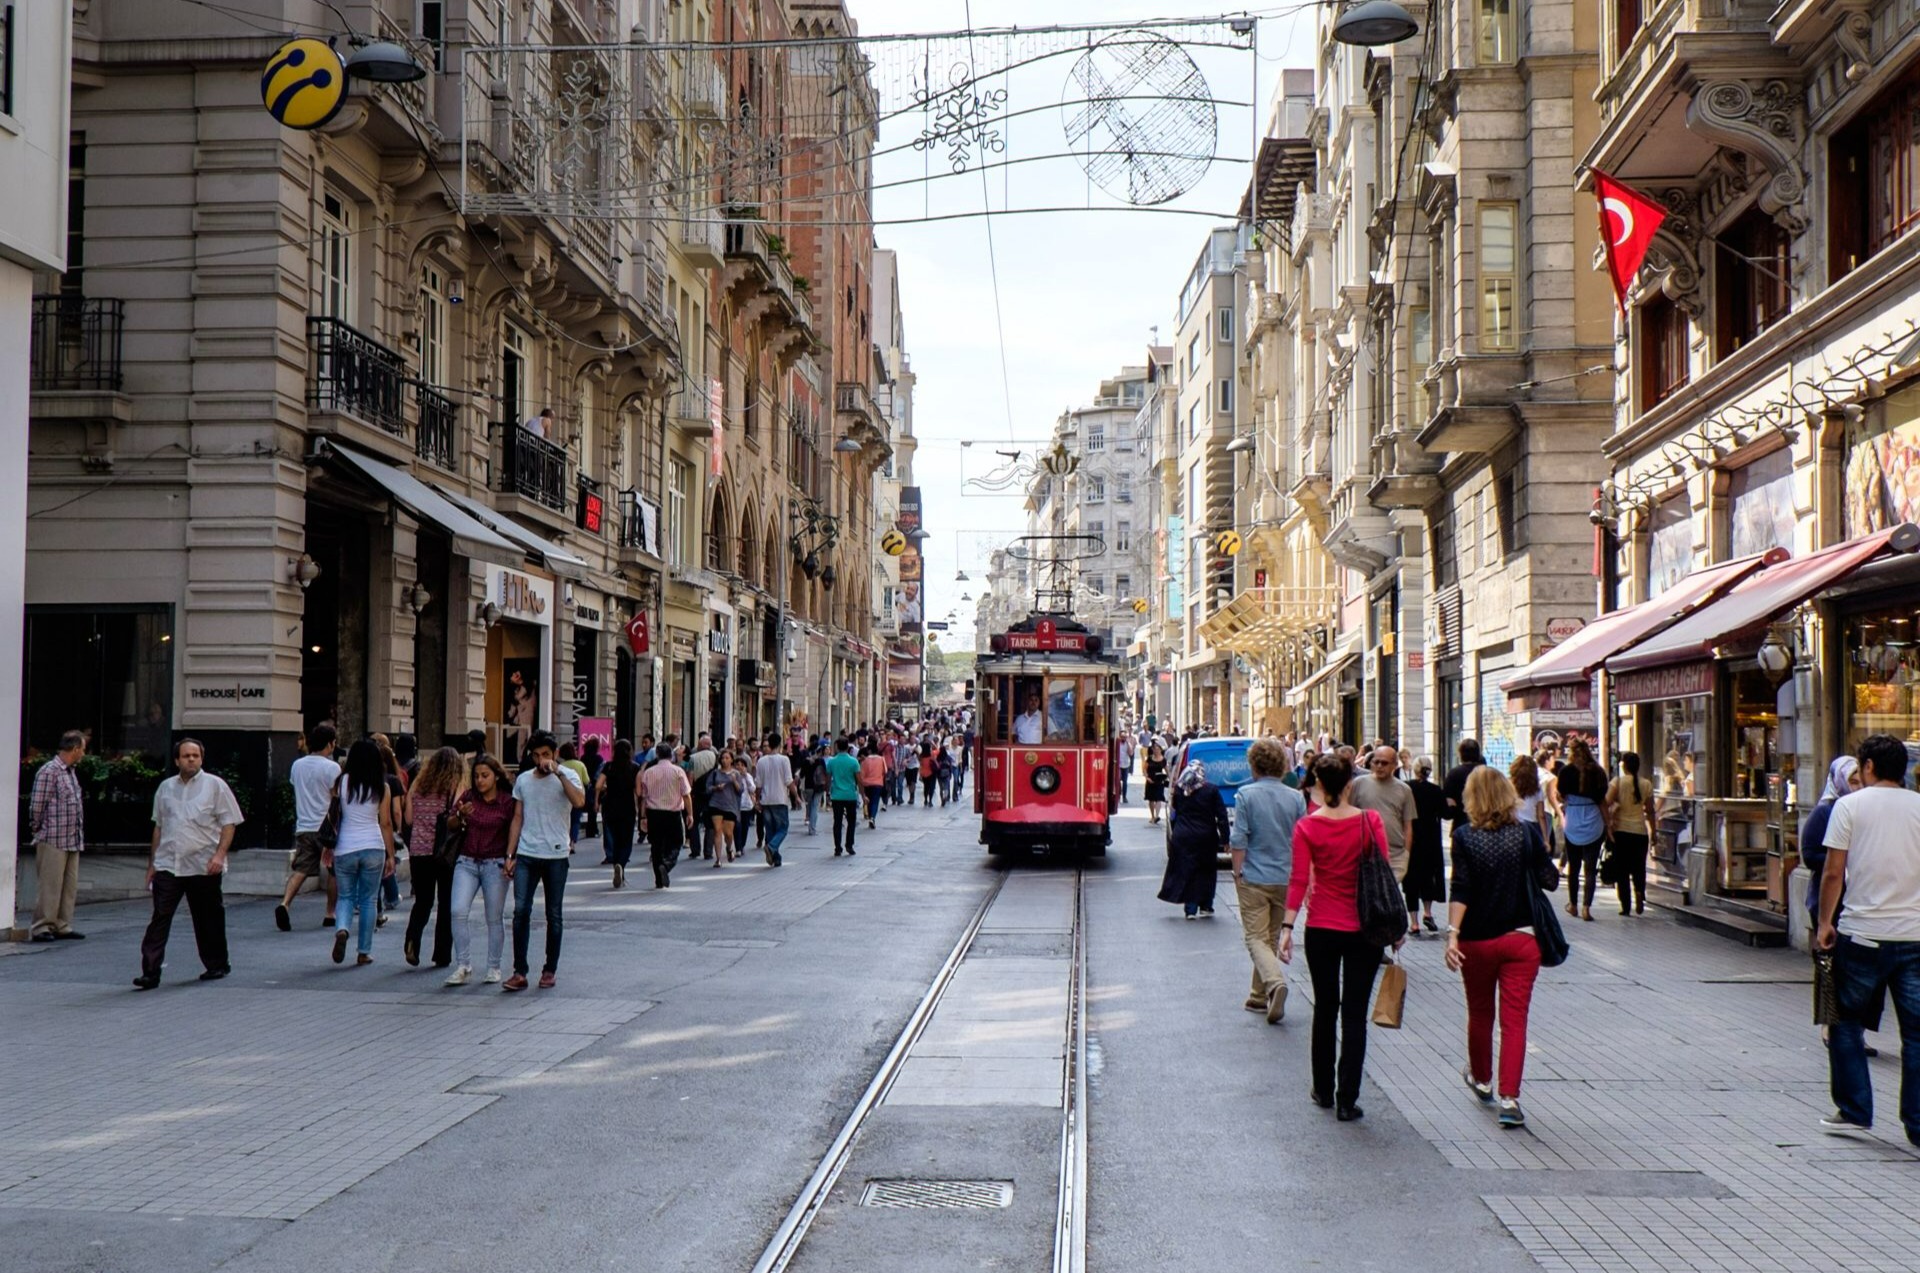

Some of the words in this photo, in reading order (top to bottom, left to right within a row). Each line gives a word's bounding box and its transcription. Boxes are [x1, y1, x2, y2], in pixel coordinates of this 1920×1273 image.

[1043, 621, 1049, 633] 3
[1055, 636, 1081, 649] TÜNEL
[1620, 672, 1660, 699] TURKISH
[1661, 664, 1708, 695] DELIGHT
[241, 688, 265, 698] CAFE
[1550, 686, 1578, 709] KOSKA
